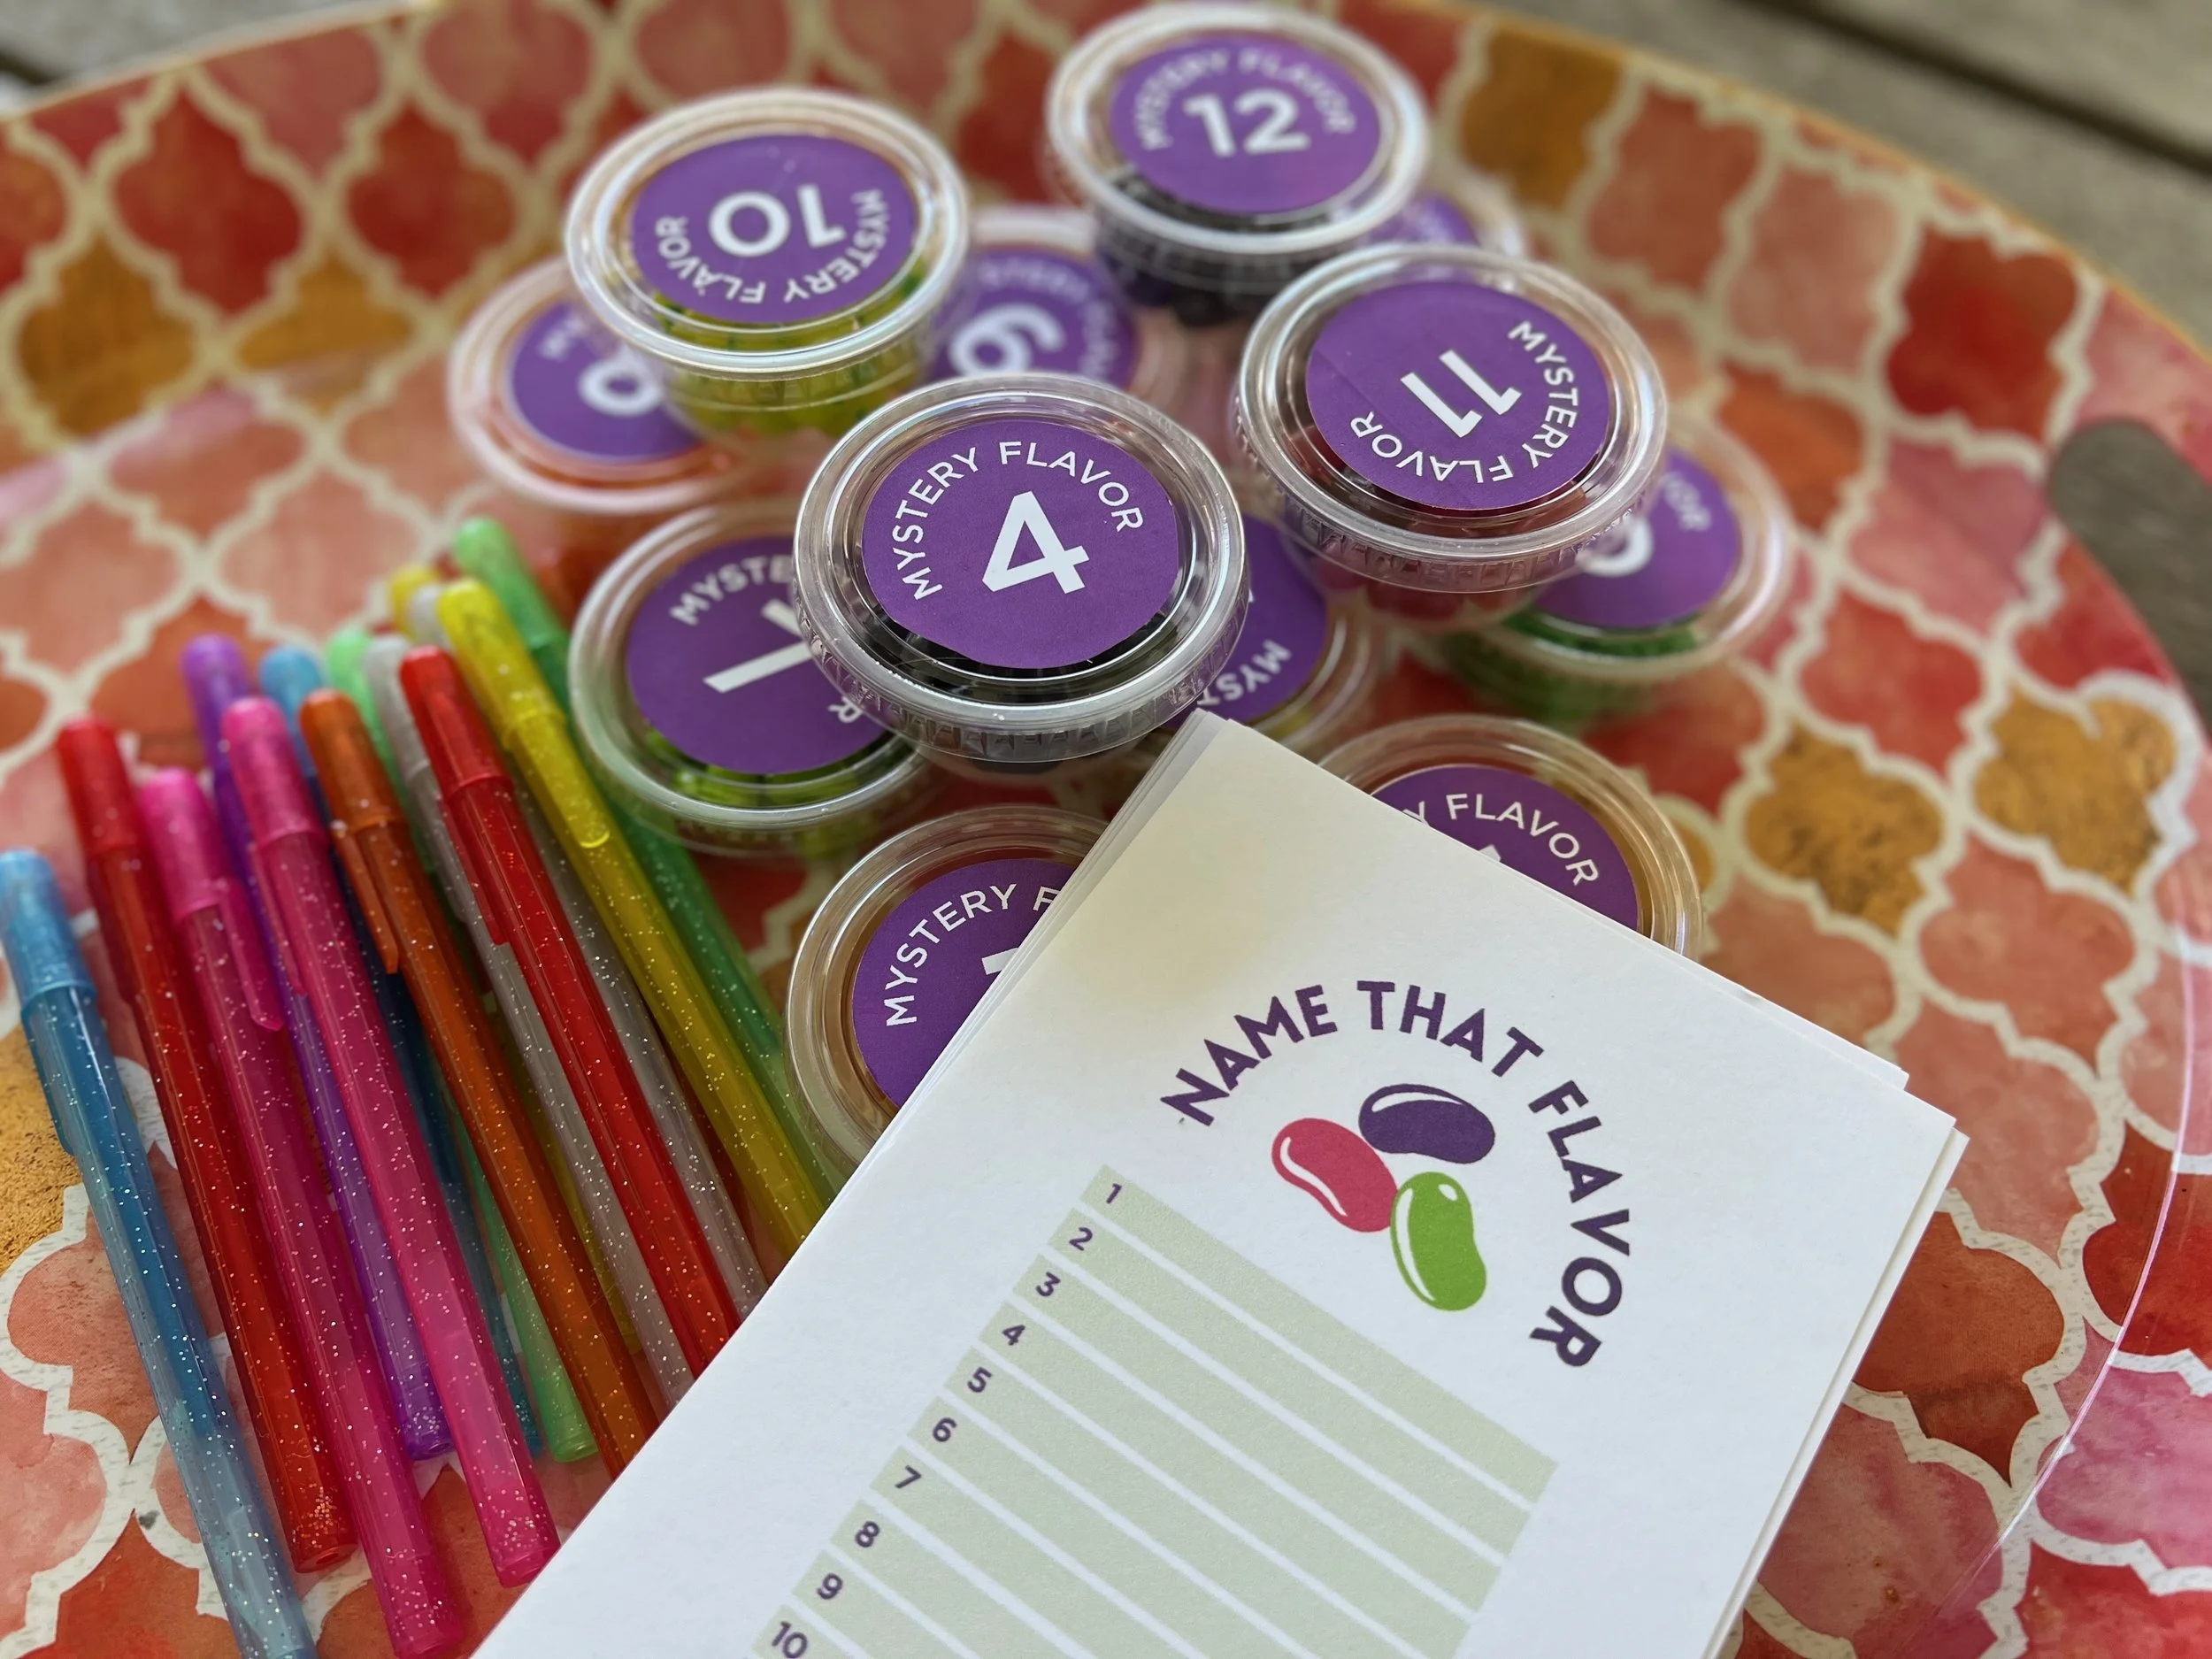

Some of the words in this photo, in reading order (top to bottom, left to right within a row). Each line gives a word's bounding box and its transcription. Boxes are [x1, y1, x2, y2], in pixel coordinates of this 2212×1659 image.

[1182, 89, 1311, 157] 12
[708, 183, 847, 258] 10
[783, 188, 889, 304] MYSTERY
[655, 216, 767, 304] FLAVOR
[1400, 349, 1522, 438] 11
[1508, 320, 1579, 469] MYSTERY
[1349, 411, 1514, 483] FLAVOR
[892, 447, 979, 601] MYSTERY
[999, 441, 1143, 532] FLAVOR
[982, 490, 1090, 594] 4
[669, 554, 796, 626] MYSTE
[1197, 639, 1293, 706] MYST
[1446, 794, 1599, 886] FLAVOR
[884, 883, 1017, 1026] MYSTERY
[1105, 1182, 1123, 1204] 1
[1160, 985, 1338, 1127] NAME
[1356, 979, 1545, 1078] THAT
[1527, 1079, 1631, 1367] FLAVOR
[1068, 1226, 1094, 1251] 2
[1035, 1271, 1062, 1298] 3
[1001, 1324, 1026, 1347] 4
[967, 1367, 994, 1394] 5
[932, 1417, 958, 1443] 6
[894, 1465, 922, 1490] 7
[854, 1520, 881, 1549] 8
[817, 1572, 843, 1601] 9
[772, 1620, 809, 1659] 10
